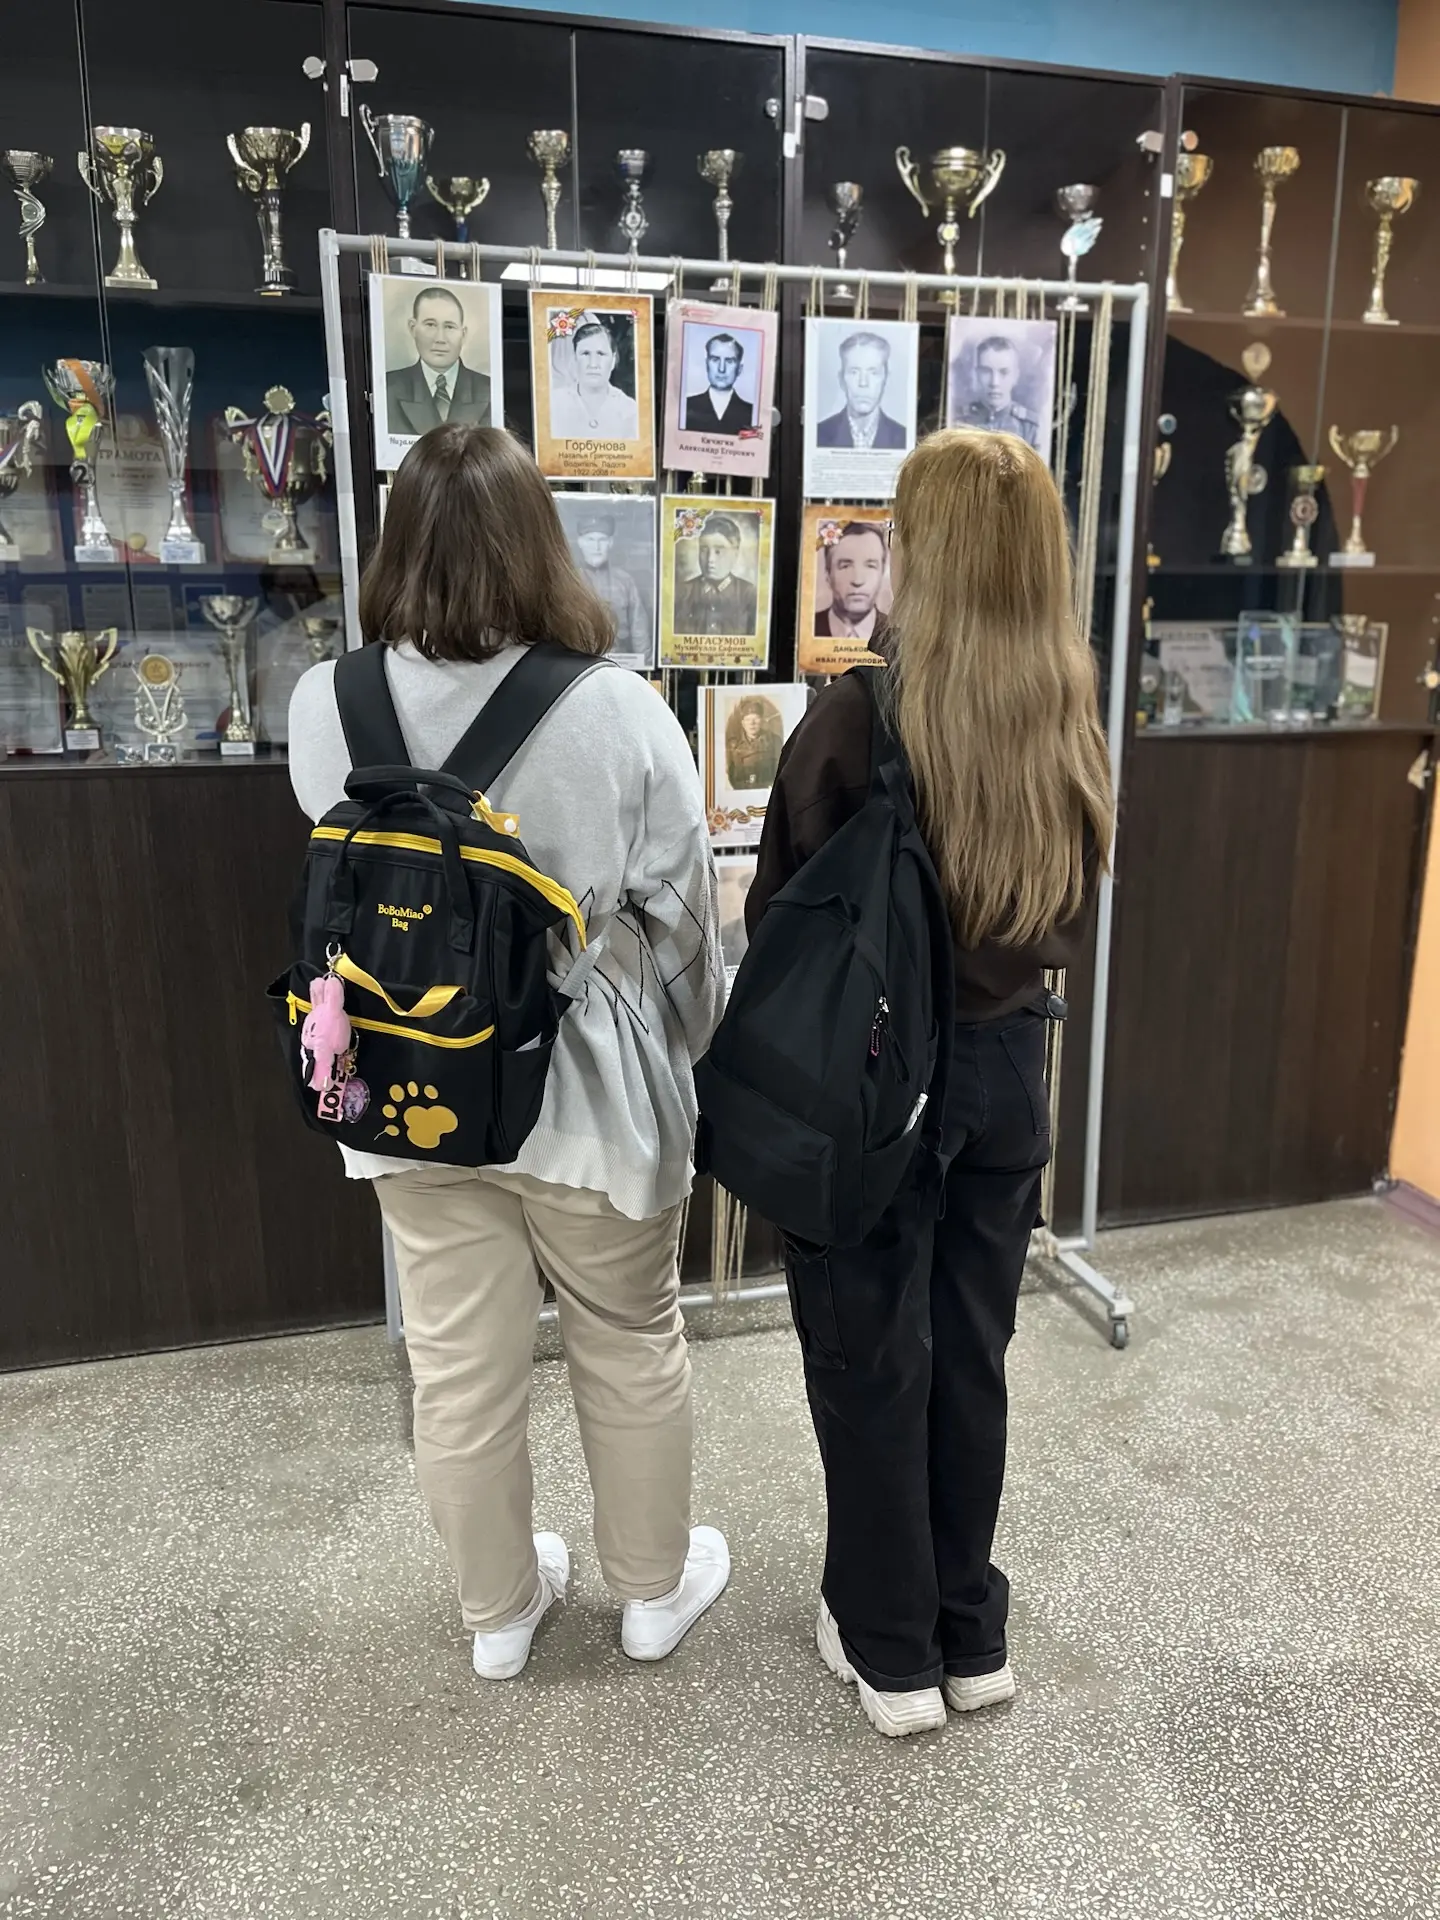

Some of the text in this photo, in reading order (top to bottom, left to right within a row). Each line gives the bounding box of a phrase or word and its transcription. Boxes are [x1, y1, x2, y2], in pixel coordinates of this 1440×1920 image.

[565, 440, 626, 453] Горбунова
[679, 444, 719, 454] Александр
[720, 448, 755, 457] Егорович
[98, 448, 163, 462] ГРАМОТА
[558, 452, 588, 460] Наталья
[73, 465, 89, 485] 2
[683, 636, 746, 646] МАГАСУМОВ
[391, 917, 409, 931] Bag
